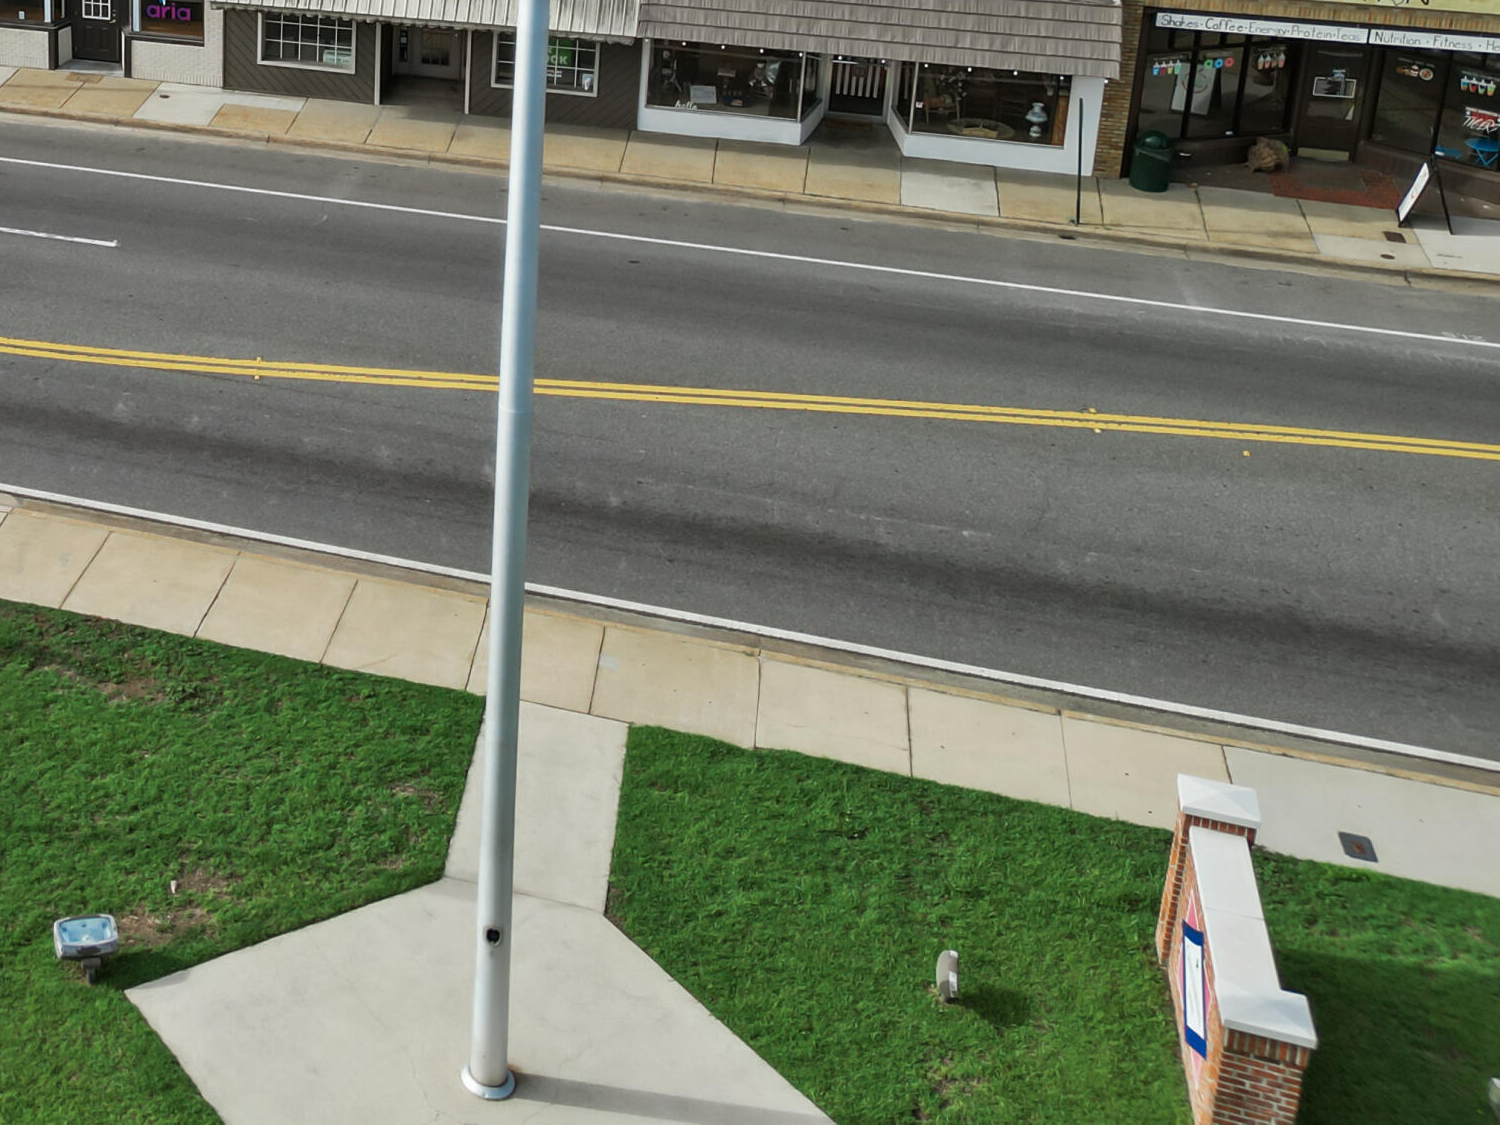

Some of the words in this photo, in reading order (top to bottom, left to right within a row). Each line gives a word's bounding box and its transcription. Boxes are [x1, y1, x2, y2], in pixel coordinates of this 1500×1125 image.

[146, 2, 191, 21] aria
[1160, 13, 1199, 29] Shakes
[1205, 17, 1244, 33] Coffee
[1249, 21, 1287, 37] Energy
[1291, 24, 1333, 39] Protein
[1336, 28, 1362, 42] Teas
[1374, 30, 1421, 46] Nutrition
[1432, 35, 1473, 50] Fitness
